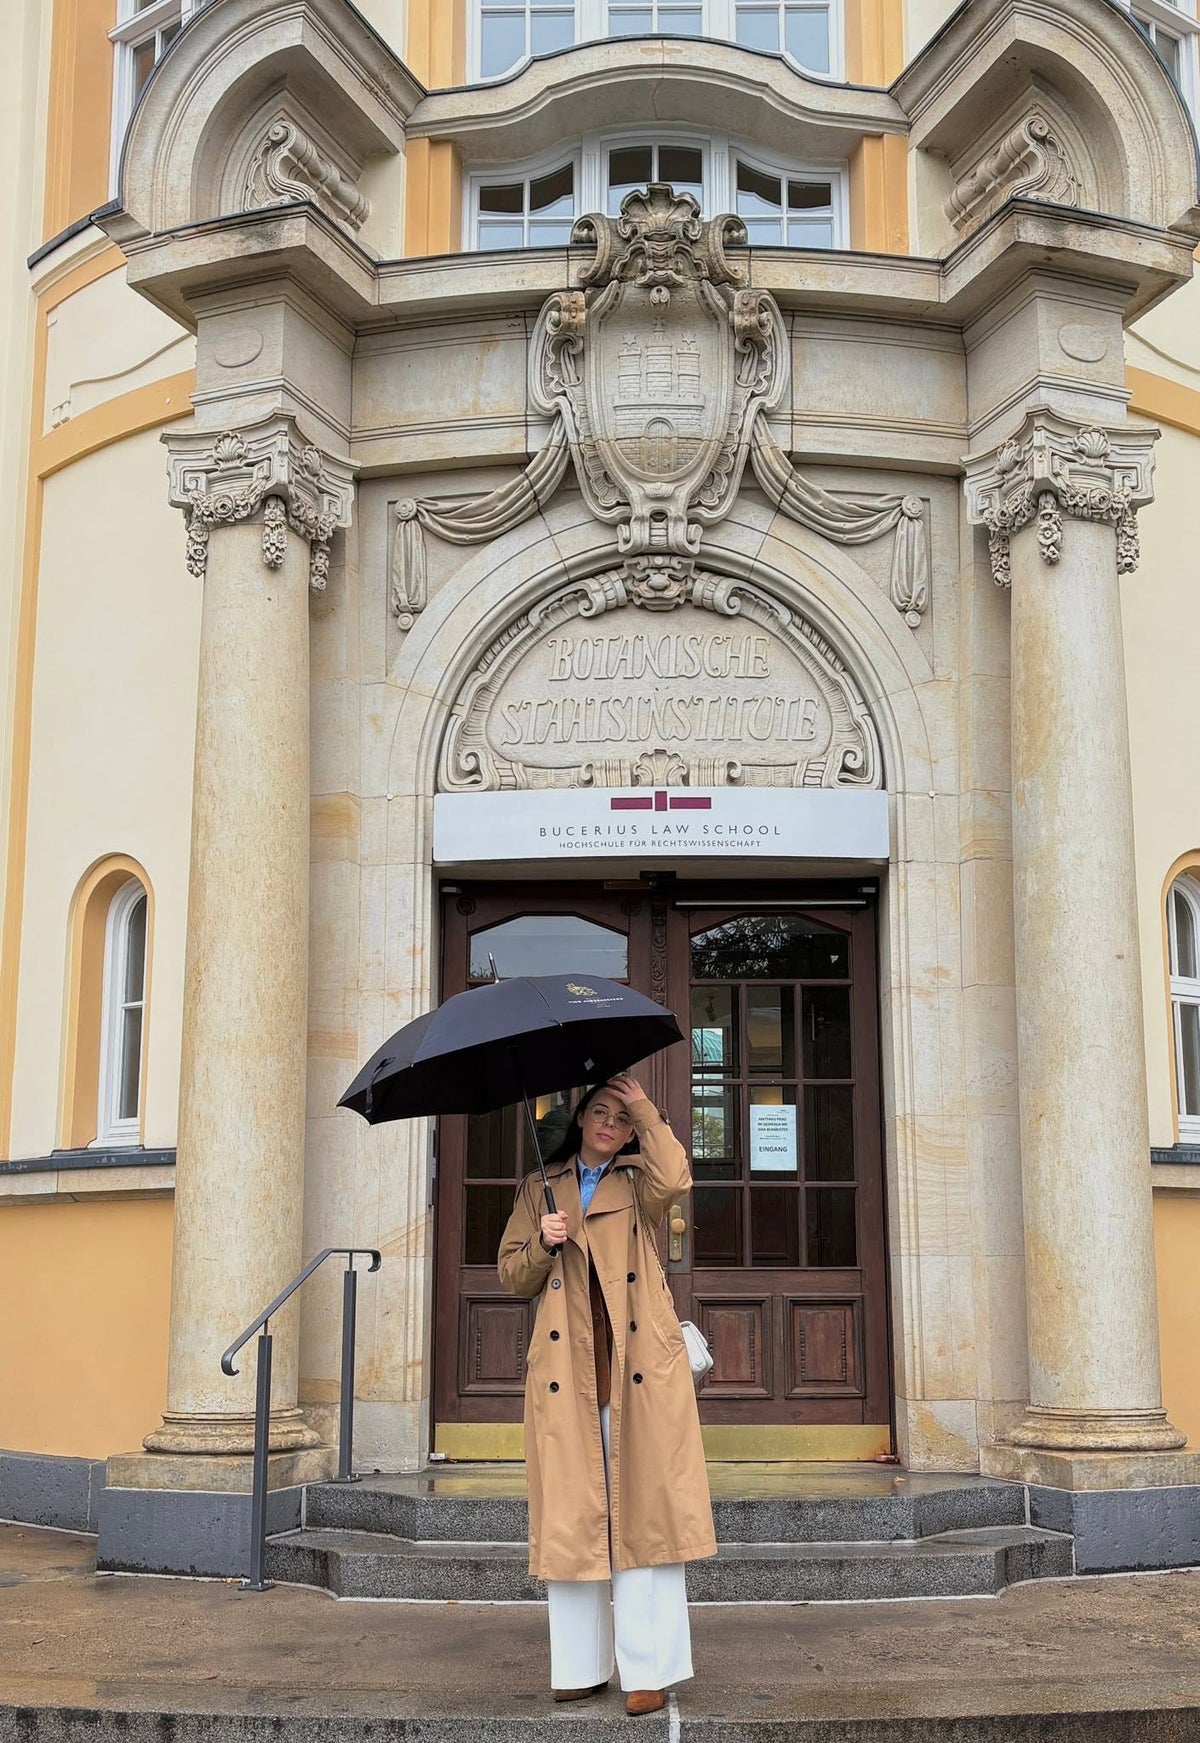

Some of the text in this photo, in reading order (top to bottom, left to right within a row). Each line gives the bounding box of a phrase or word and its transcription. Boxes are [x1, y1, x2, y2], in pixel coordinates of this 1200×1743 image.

[548, 634, 770, 681] BOTANISCHE
[500, 695, 819, 745] STAATSINSTITUTE
[539, 824, 781, 837] BUCERIUS LAW SCHOOL
[559, 838, 762, 848] HOCHSCHULE FÜR RECHTSWISSENSCHAFT
